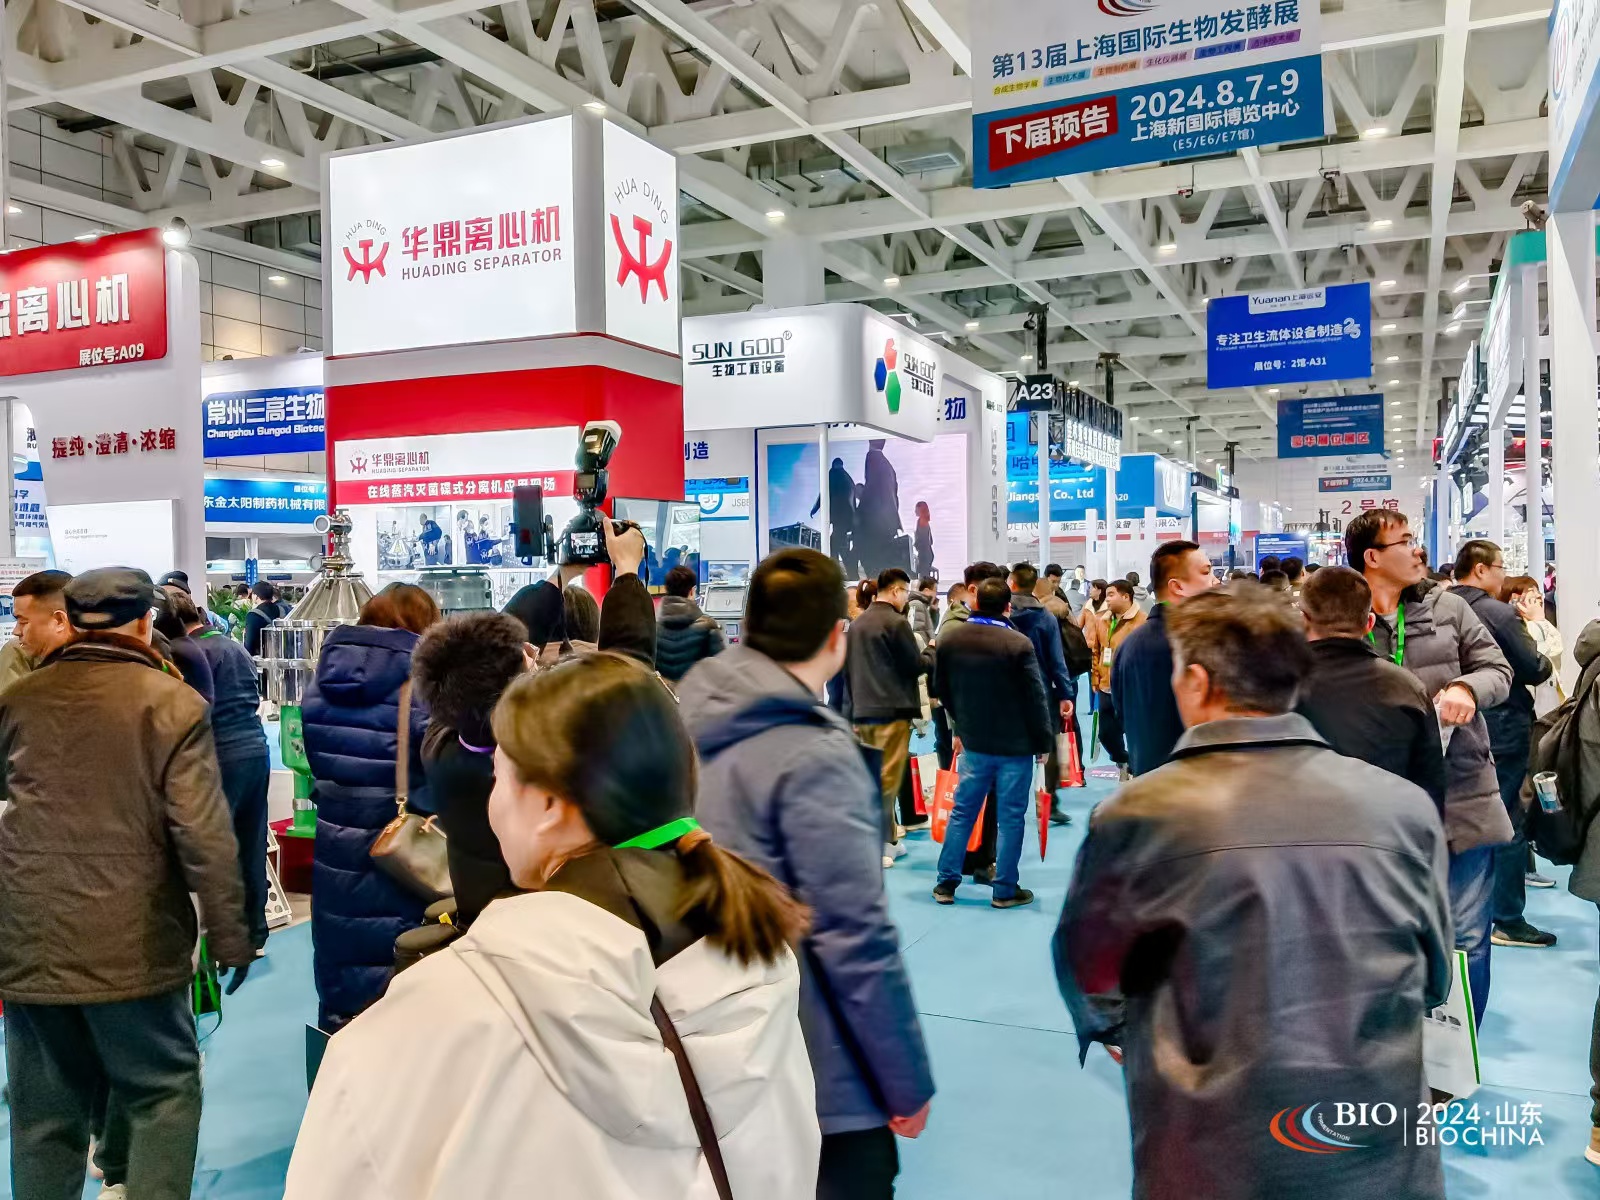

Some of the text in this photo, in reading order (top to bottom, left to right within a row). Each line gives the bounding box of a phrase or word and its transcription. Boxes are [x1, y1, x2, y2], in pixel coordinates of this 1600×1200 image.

[992, 0, 1299, 79] 第13届上海国际生物发酵展
[1130, 69, 1300, 121] 2024.8.7-9
[995, 105, 1111, 155] 下届预告
[1130, 99, 1300, 142] 上海新国际博览中心
[1172, 129, 1255, 152] (E5/E6/E7馆)
[613, 177, 669, 225] HUA DING
[345, 218, 388, 241] HUA DING
[401, 205, 560, 261] 华鼎离心机
[402, 248, 563, 281] HUADING SEPARATOR
[1251, 295, 1291, 306] Yuanan
[1215, 323, 1343, 346] 专注卫生流体设备制造
[79, 343, 144, 366] 展位号:A09
[692, 342, 732, 360] SUN
[712, 360, 784, 377] 生物工程设备
[1017, 383, 1054, 401] A23
[207, 393, 325, 426] 常州三高生物
[52, 427, 176, 459] 提纯·澄清·浓缩
[207, 429, 254, 440] Changzhou
[371, 451, 430, 467] 华鼎离心机
[1076, 488, 1094, 499] Ltd
